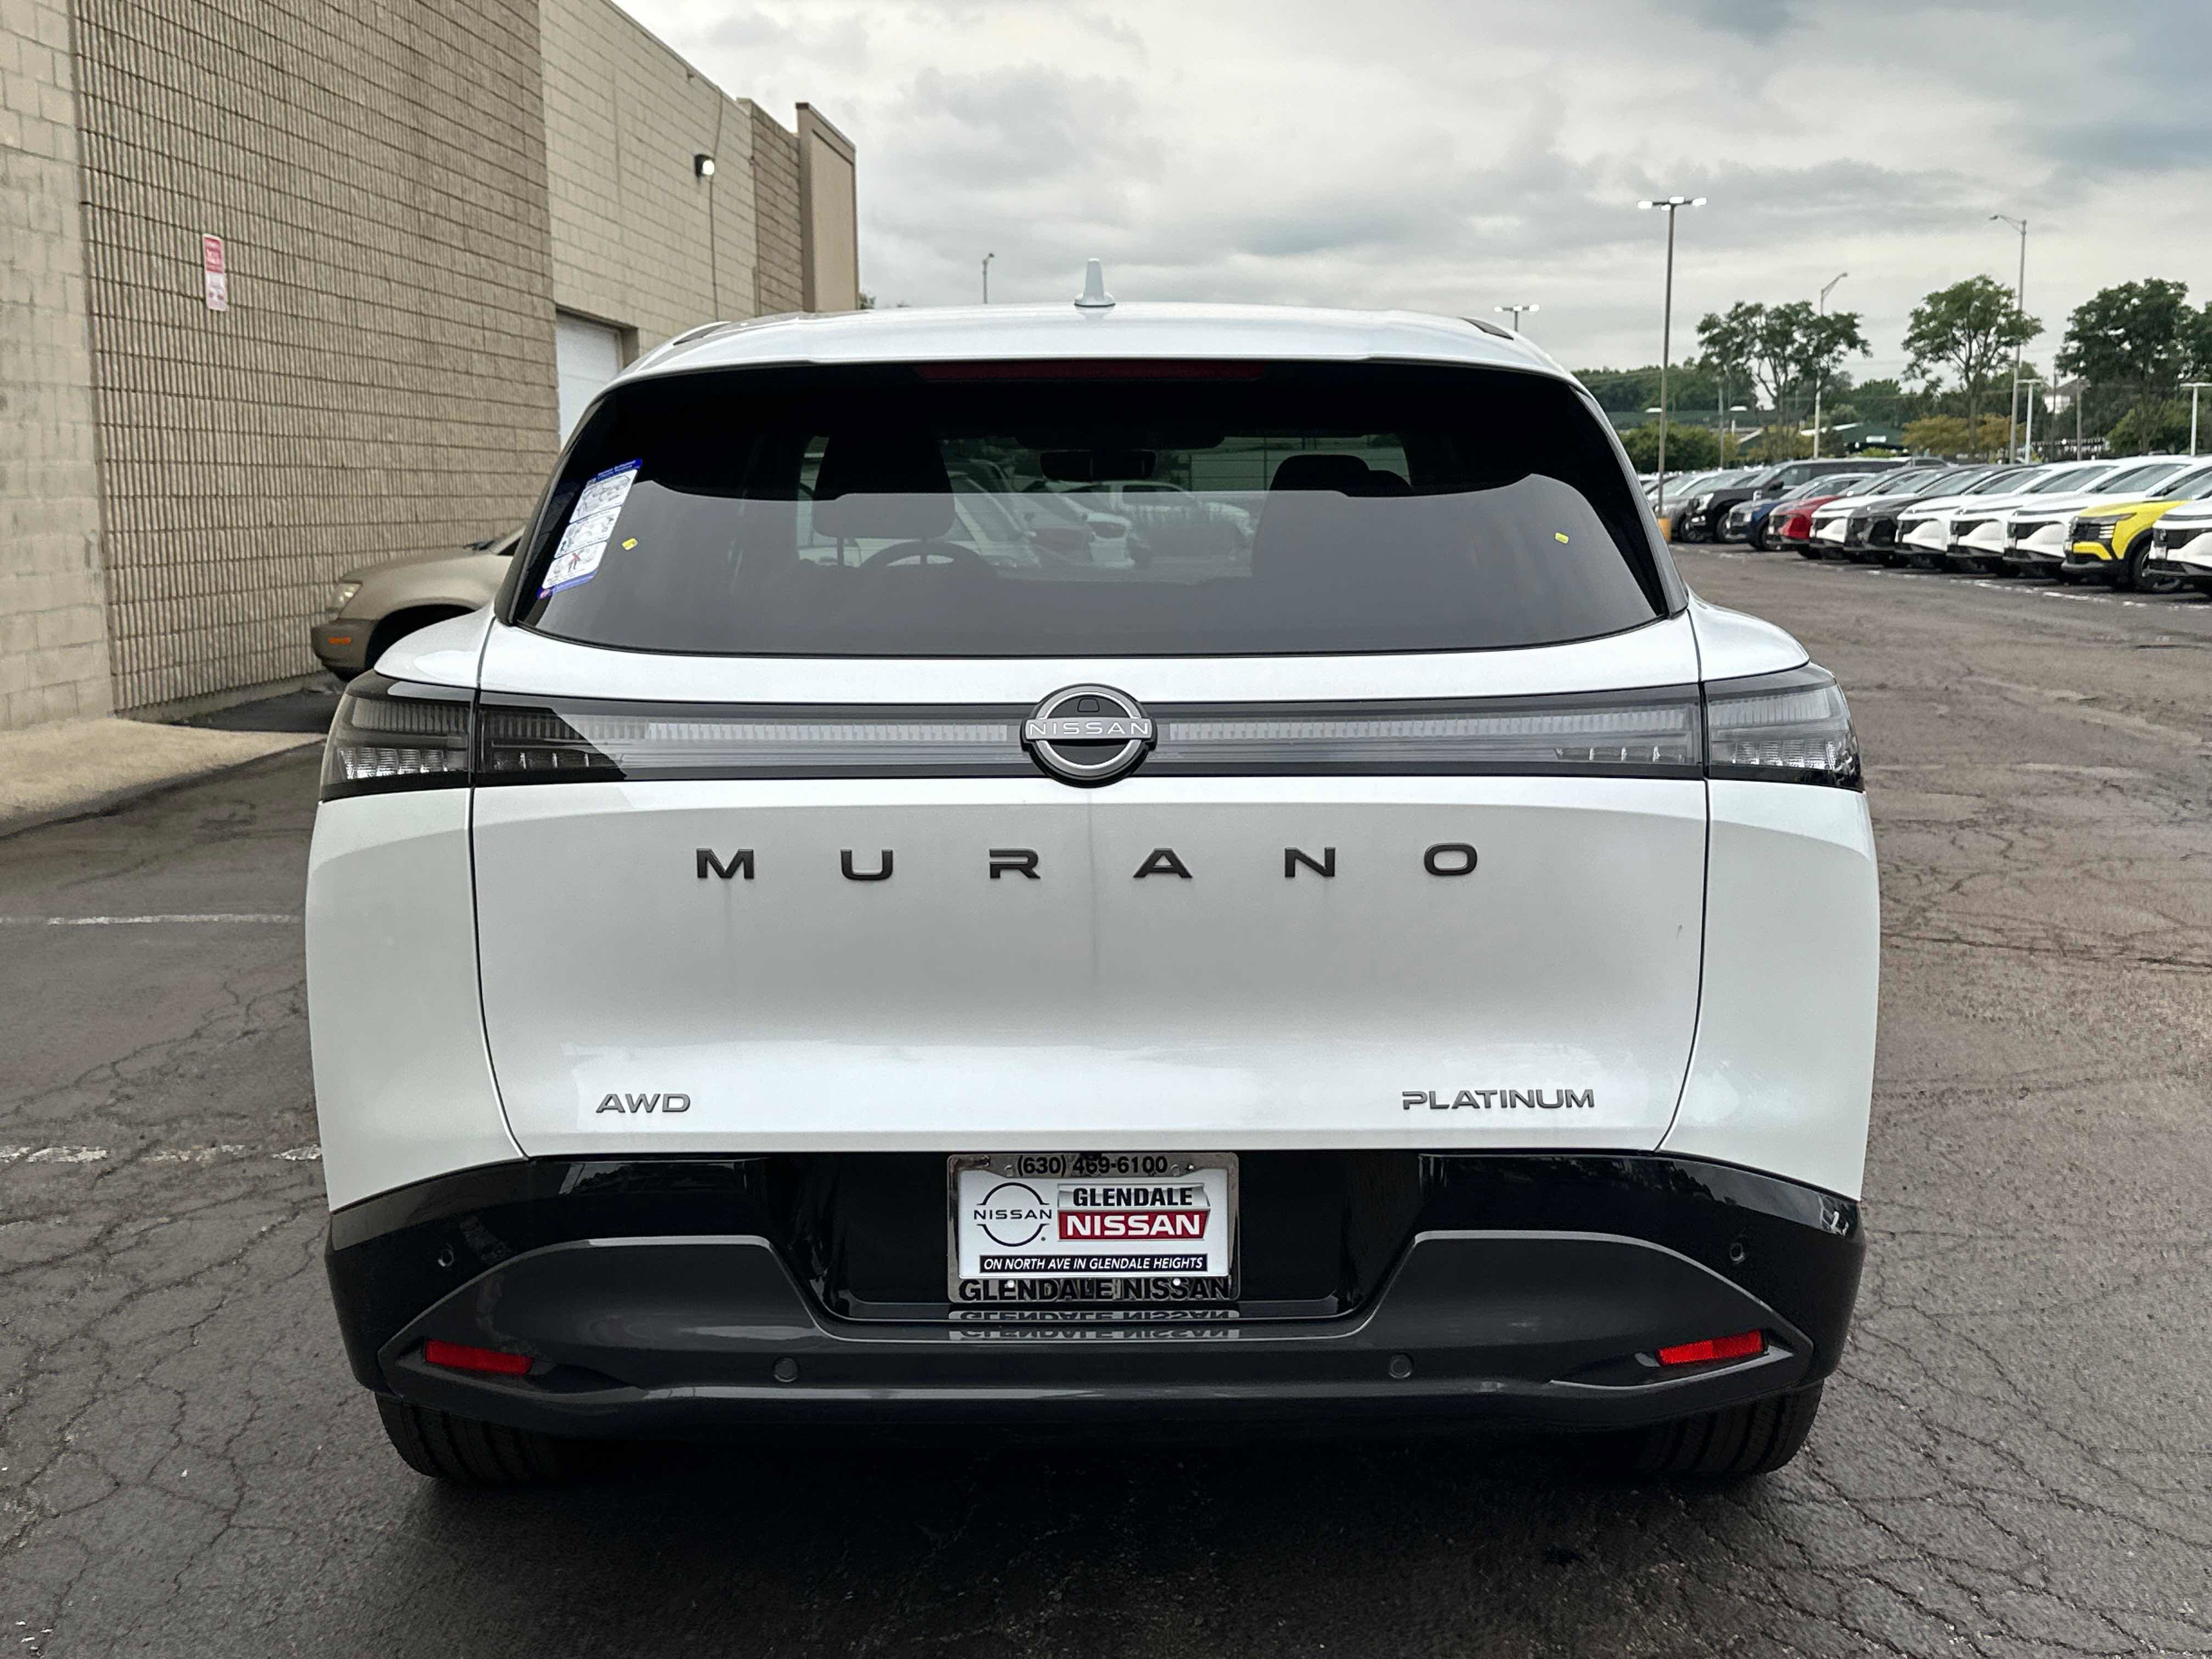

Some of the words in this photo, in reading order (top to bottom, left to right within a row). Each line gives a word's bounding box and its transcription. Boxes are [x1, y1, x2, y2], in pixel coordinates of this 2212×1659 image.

[1029, 721, 1149, 735] NISSAN
[696, 843, 1479, 881] MURANO
[596, 1093, 691, 1113] AWD
[1402, 1089, 1594, 1110] PLATINUM
[1017, 1154, 1066, 1177] (630)
[1073, 1187, 1193, 1206] GLENDALE
[974, 1209, 1052, 1220] NISSAN
[1066, 1214, 1200, 1236] NISSAN
[984, 1259, 1002, 1270] ON
[1005, 1259, 1046, 1270] NORTH
[1047, 1258, 1071, 1269] AVE
[1073, 1258, 1087, 1269] IN
[1089, 1258, 1152, 1269] GLENDALE
[1153, 1257, 1204, 1269] HEIGHTS
[959, 1279, 1113, 1301] GLENDALE
[1121, 1277, 1229, 1300] NISSAN
